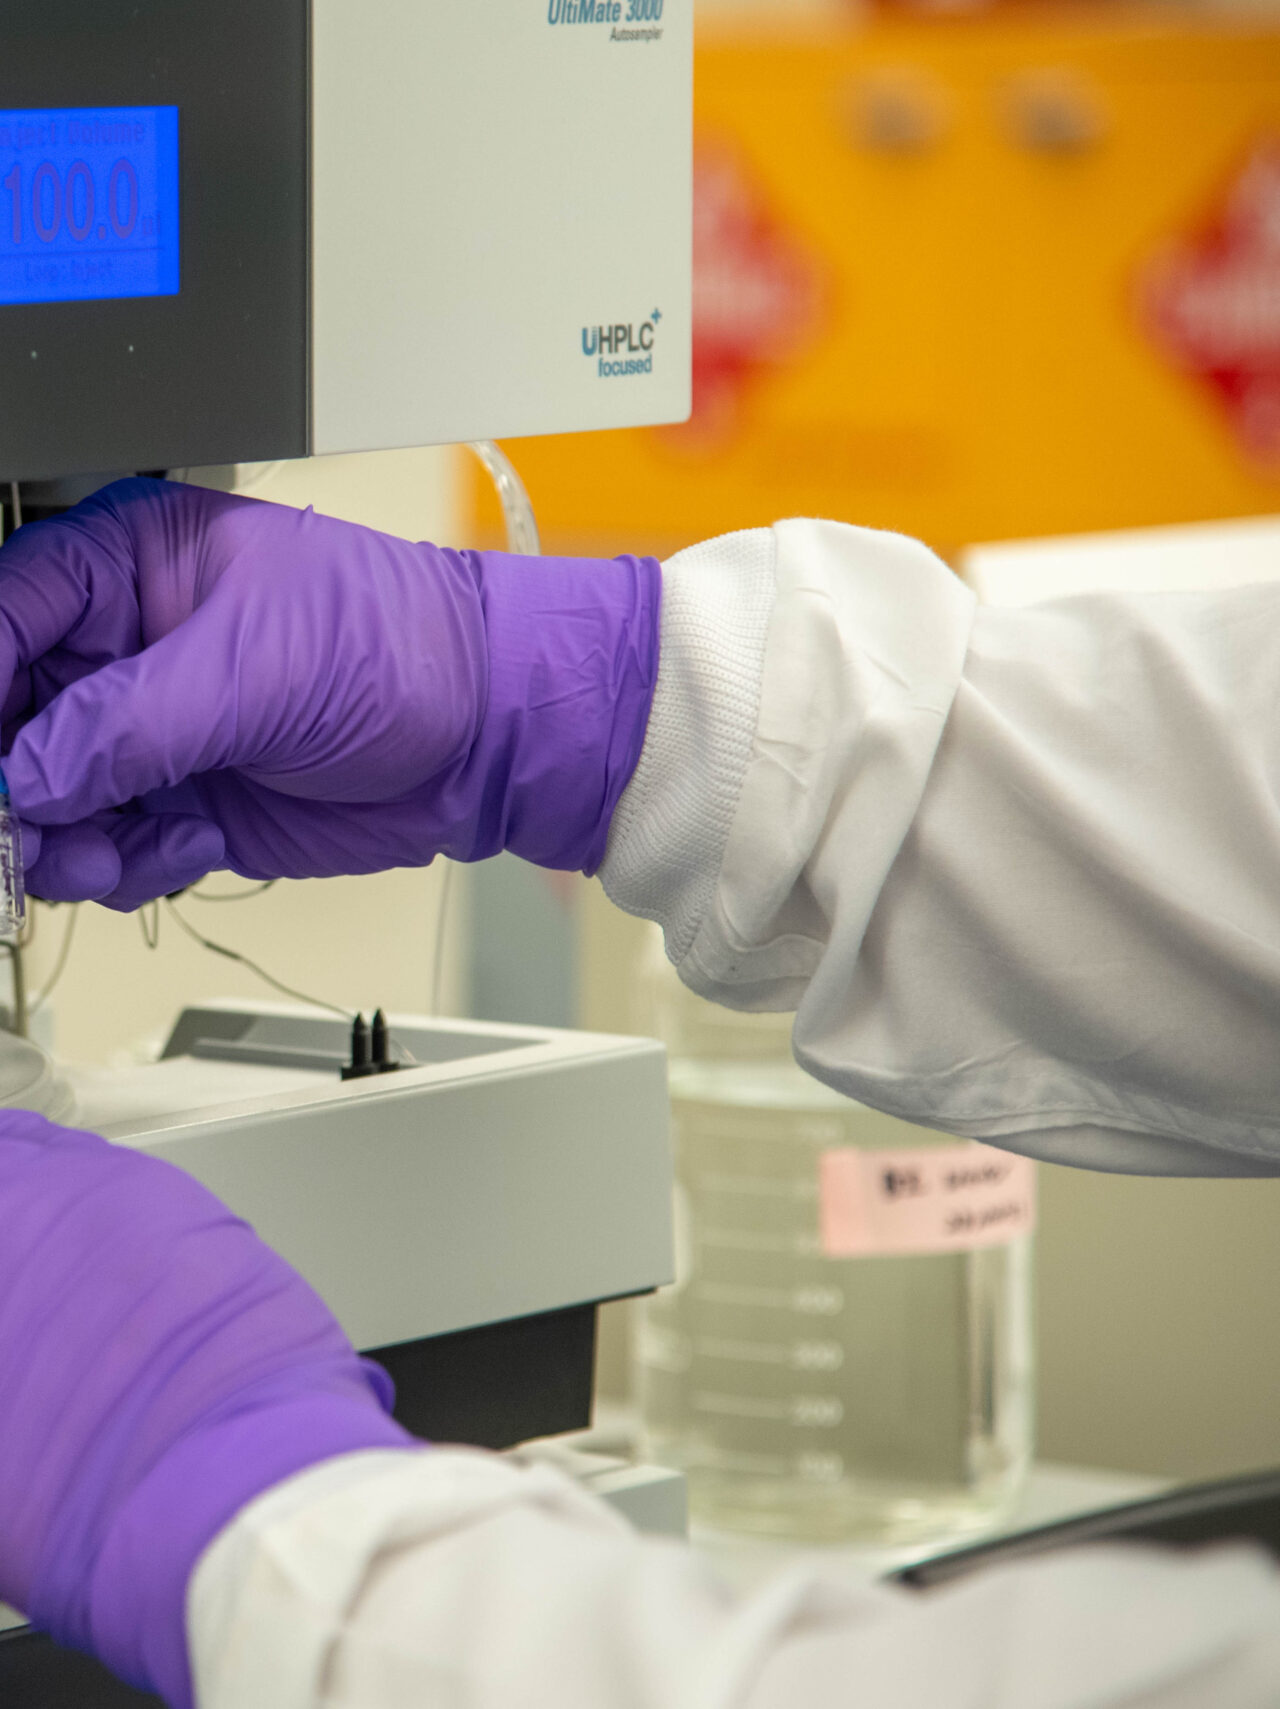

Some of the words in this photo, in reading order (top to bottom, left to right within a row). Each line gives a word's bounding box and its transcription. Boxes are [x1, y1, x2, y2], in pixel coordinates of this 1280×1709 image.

[548, 0, 622, 24] UltiMate
[625, 0, 665, 22] 3000
[609, 26, 663, 43] Autosampler
[4, 156, 139, 245] 100.0
[597, 353, 653, 378] focused
